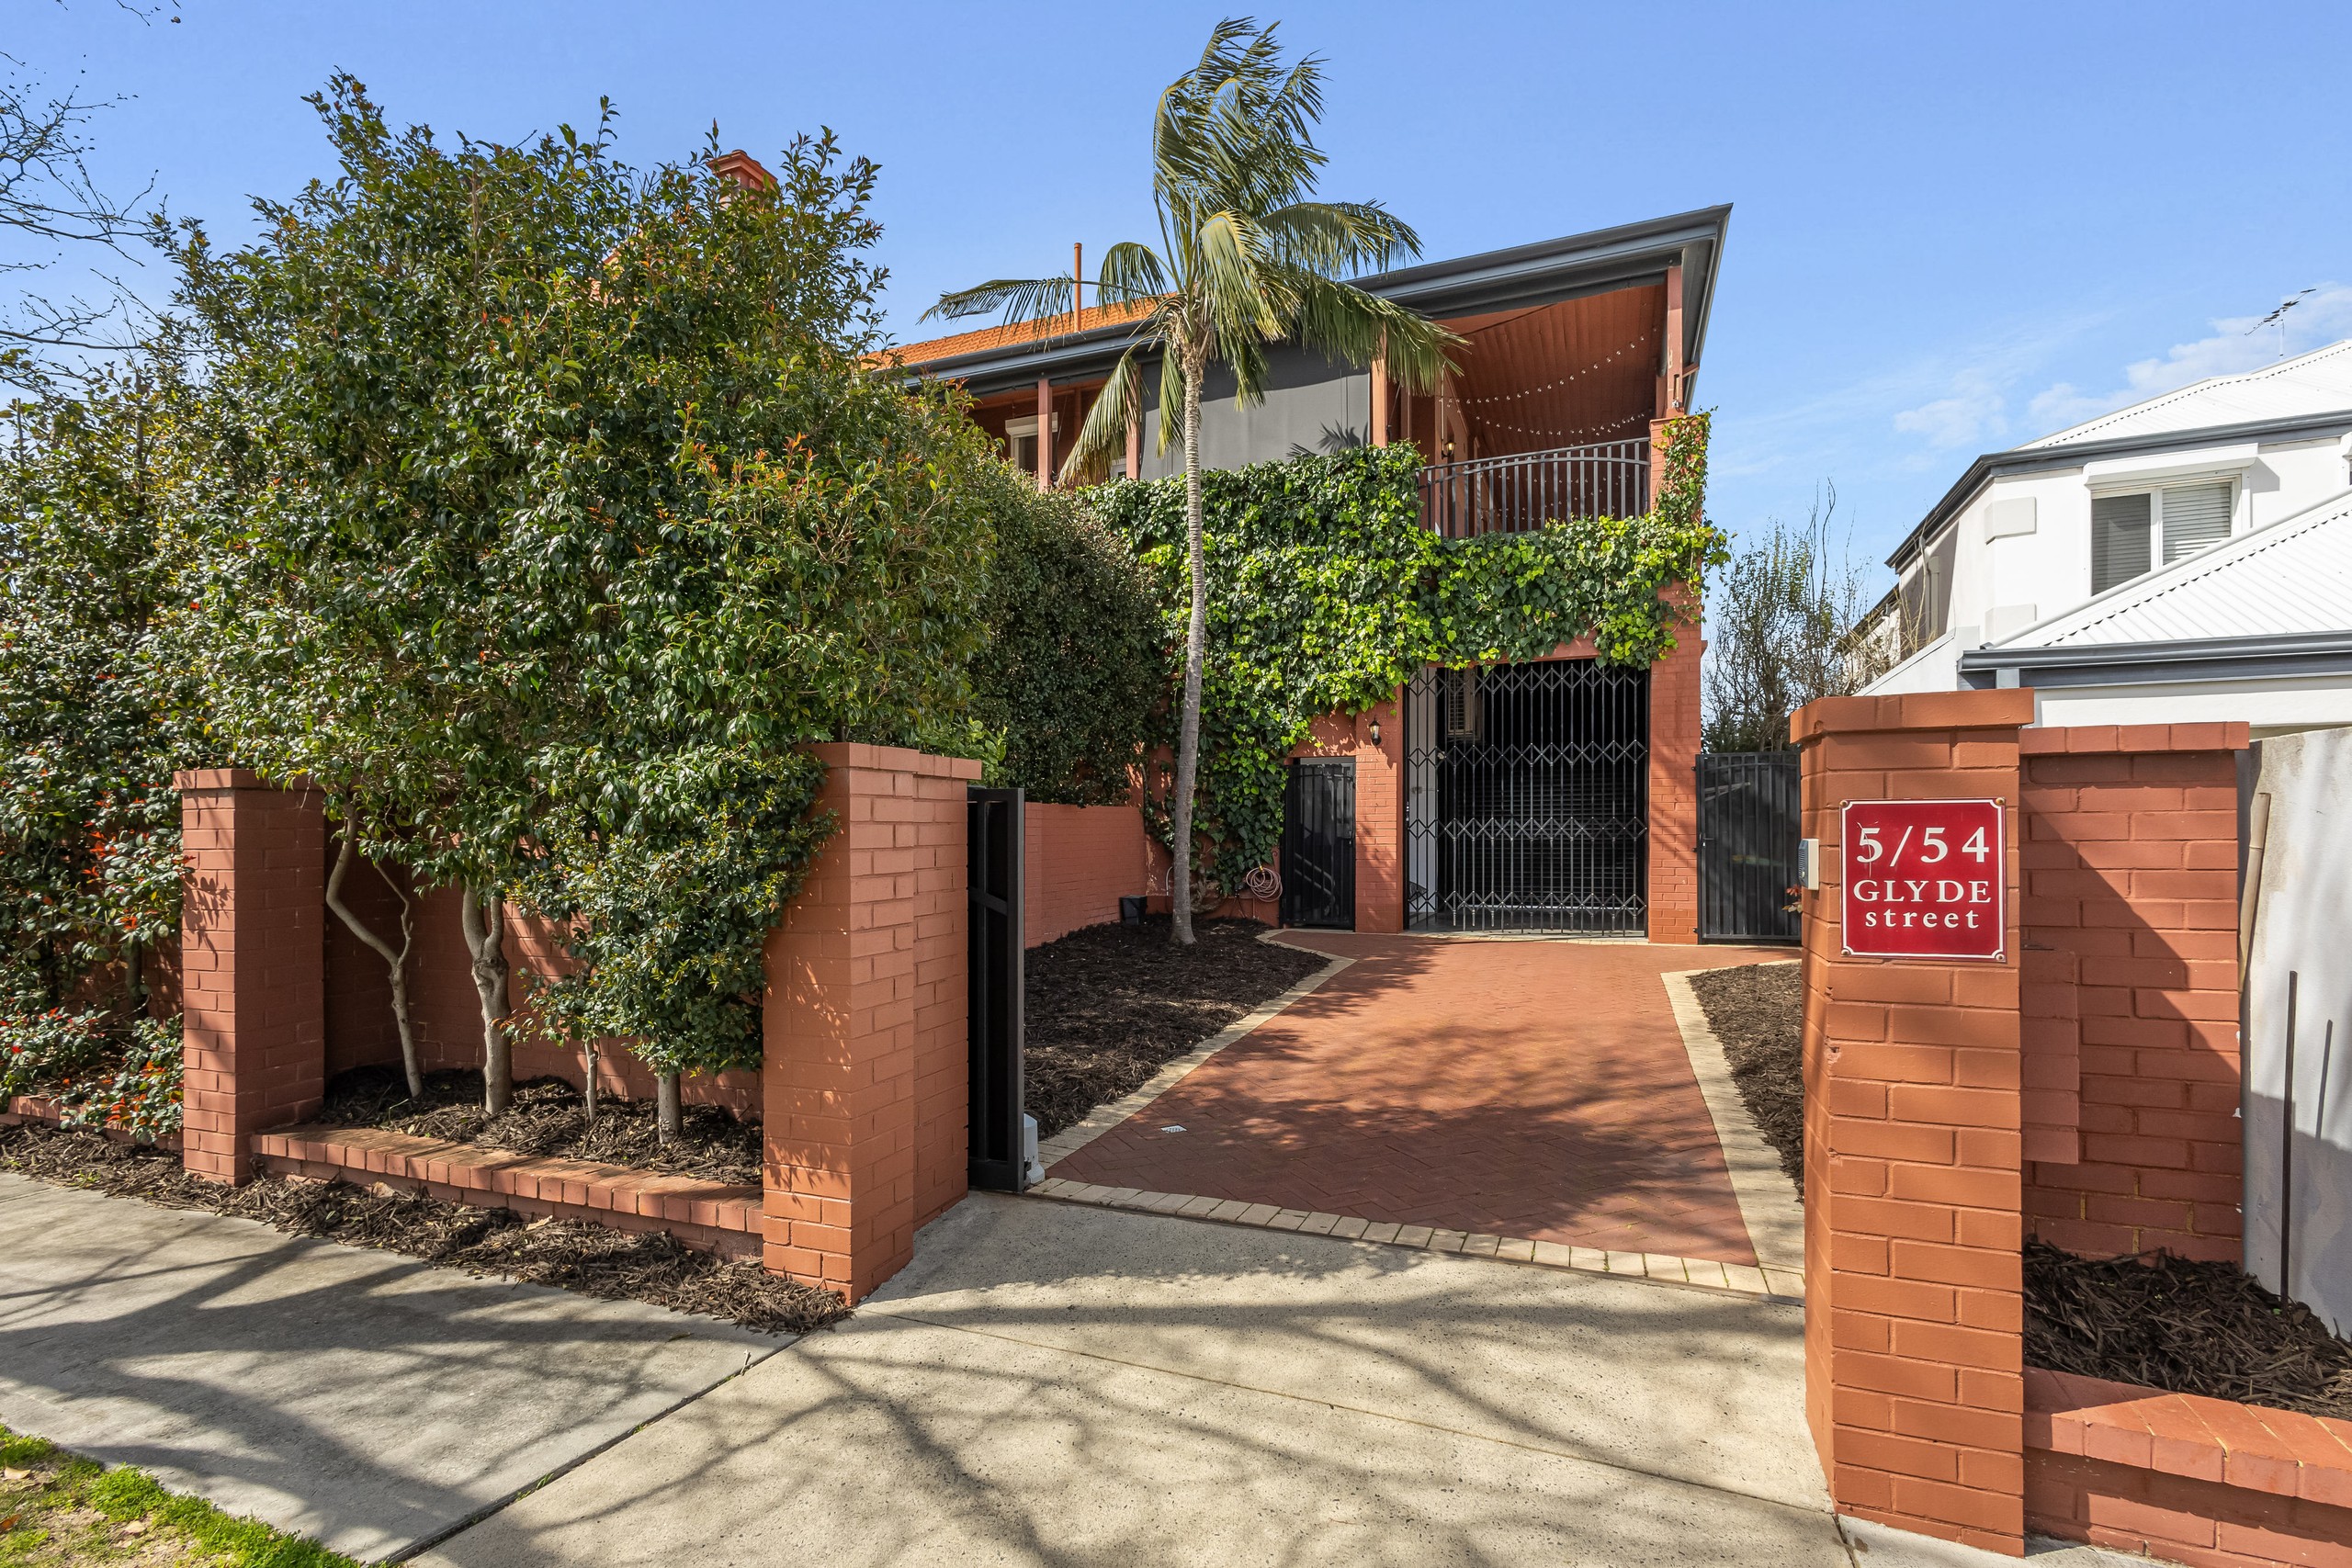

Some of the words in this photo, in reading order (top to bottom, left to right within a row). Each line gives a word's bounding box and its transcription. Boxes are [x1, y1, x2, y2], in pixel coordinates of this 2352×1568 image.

[1857, 826, 1989, 866] 5/54
[1853, 880, 1991, 903] GLYDE
[1865, 908, 1979, 929] street
